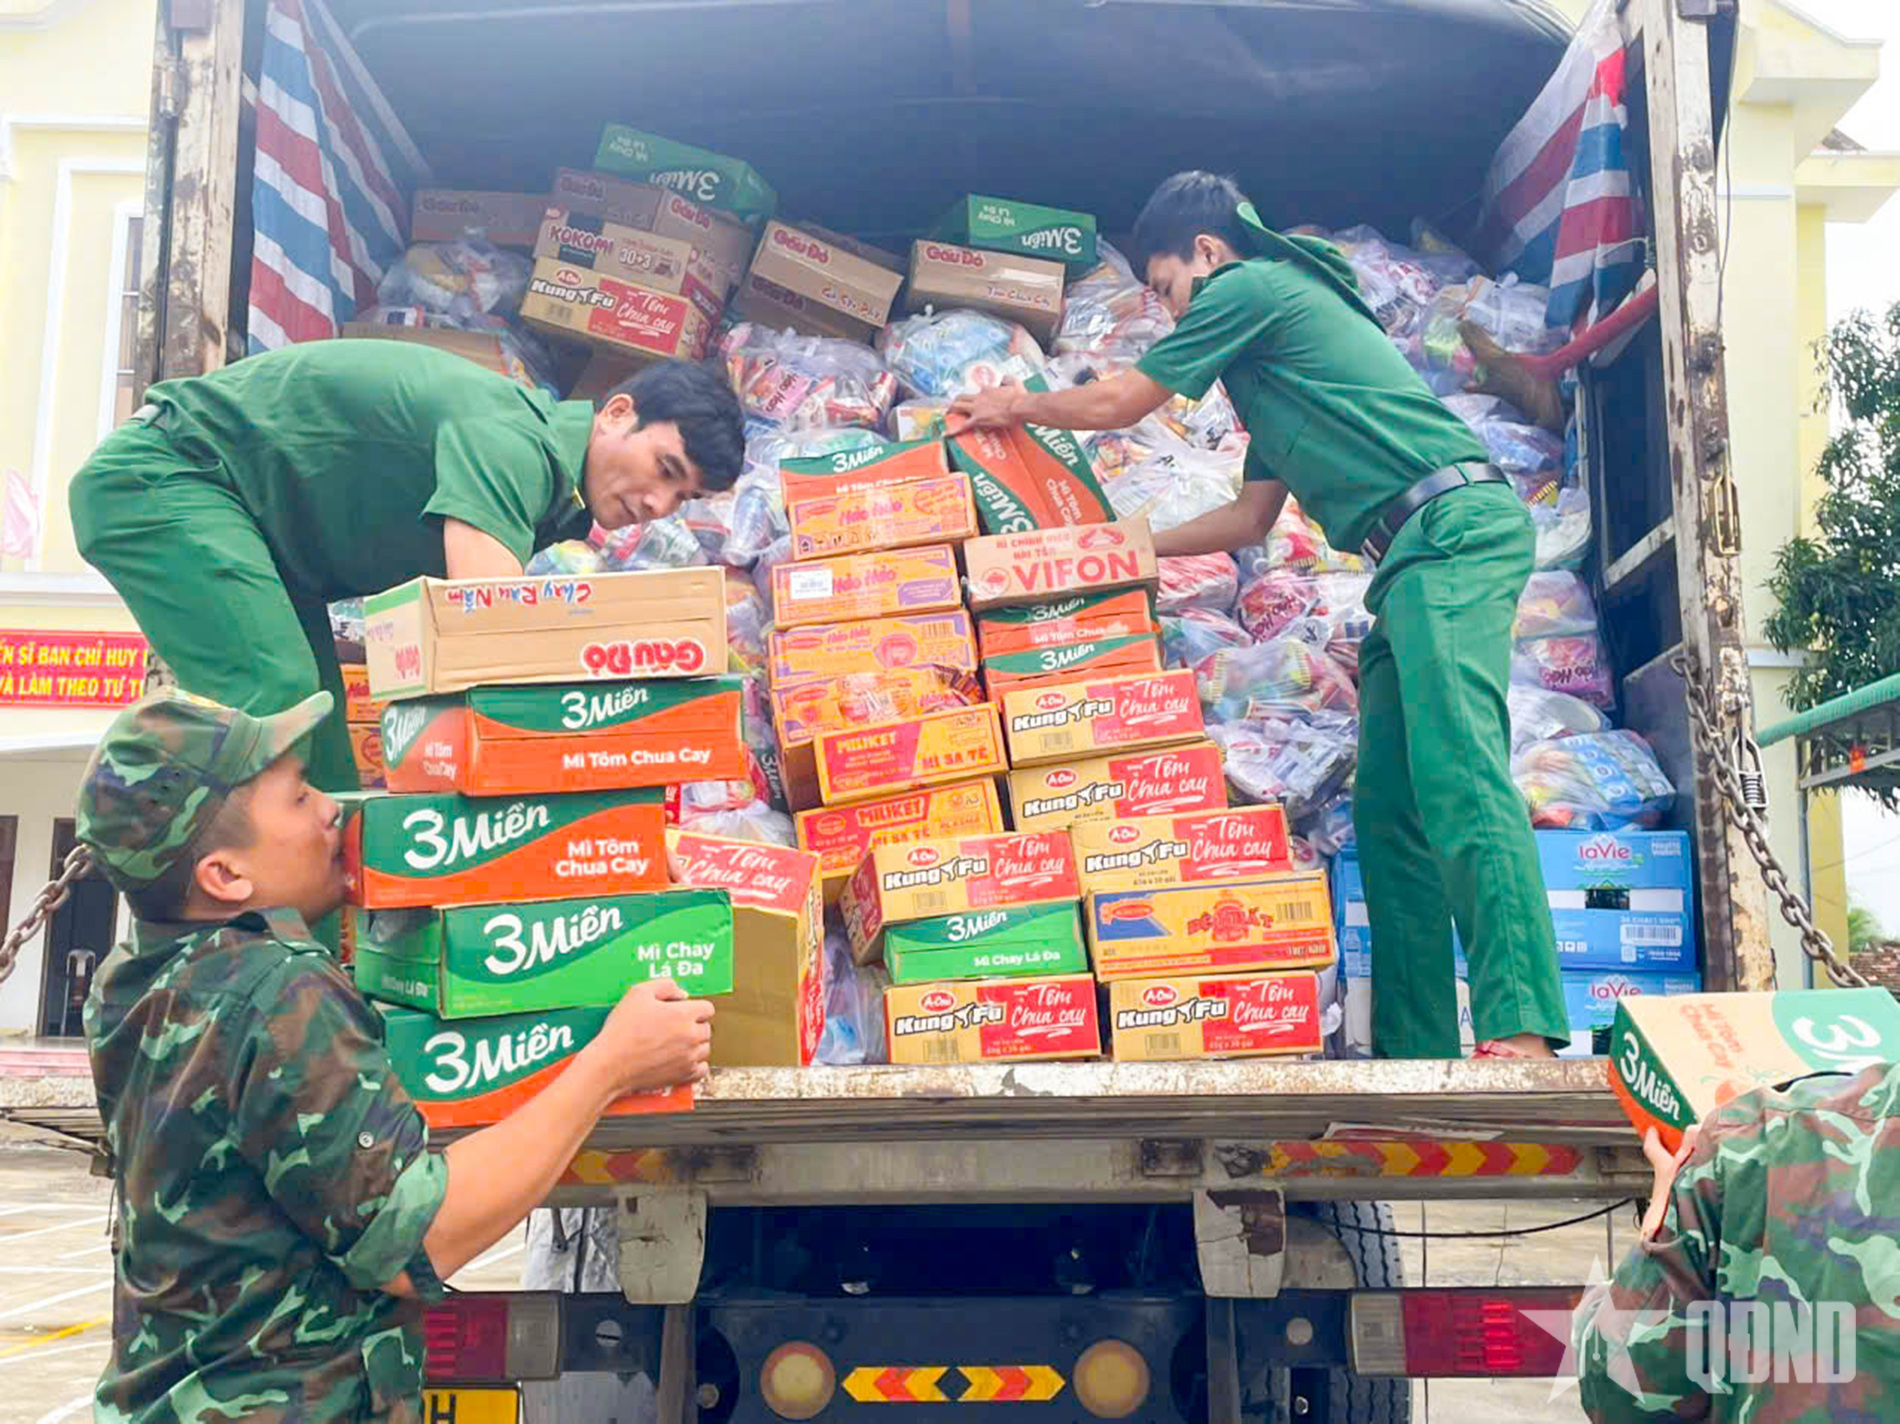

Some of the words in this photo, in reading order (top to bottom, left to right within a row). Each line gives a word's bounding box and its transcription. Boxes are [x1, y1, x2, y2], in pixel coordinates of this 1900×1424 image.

[550, 225, 614, 255] KOKOMI
[619, 249, 652, 271] 30+3
[530, 278, 577, 300] Kung
[593, 292, 617, 309] Fu
[1012, 550, 1140, 591] VIFON
[447, 585, 492, 613] Nấm
[499, 584, 537, 606] Rau
[543, 581, 592, 604] Chay
[38, 645, 70, 665] BAN
[107, 646, 138, 667] HUY
[58, 677, 99, 697] THEO
[1134, 678, 1176, 698] Tôm
[561, 691, 587, 729] 3
[586, 685, 649, 727] Miền
[1013, 709, 1068, 733] Kung
[1084, 699, 1114, 717] Fu
[1119, 697, 1158, 718] Chua
[1164, 696, 1190, 714] cay
[563, 752, 586, 769] Mì
[587, 749, 627, 767] Tôm
[630, 748, 676, 766] Chua
[678, 746, 711, 766] Cay
[1143, 754, 1189, 776] Tôm
[1023, 797, 1079, 818] Kung
[1096, 783, 1125, 801] Fu
[1128, 779, 1172, 801] Chua
[1179, 776, 1207, 794] cay
[857, 797, 925, 826] MILIKET
[402, 809, 449, 870] 3
[447, 799, 551, 865] Miền
[1208, 815, 1255, 840] Tôm
[568, 839, 592, 857] Mì
[595, 837, 639, 857] Tôm
[722, 844, 778, 871] Tôm
[1008, 834, 1050, 857] Tôm
[1085, 850, 1142, 873] Kung
[1159, 840, 1189, 859] Fu
[1192, 839, 1239, 861] Chua
[1243, 838, 1272, 859] cay
[556, 857, 609, 878] Chua
[612, 857, 650, 878] Cay
[686, 860, 749, 886] Chua
[752, 872, 792, 894] cay
[884, 867, 941, 891] Kung
[958, 857, 987, 876] Fu
[994, 857, 1036, 877] Chua
[1040, 856, 1065, 874] cay
[946, 916, 965, 941] 3
[964, 910, 1008, 940] Miền
[482, 913, 528, 975] 3
[523, 904, 623, 971] Miền
[638, 943, 662, 962] Mì
[666, 941, 716, 963] Chay
[676, 960, 704, 977] Đa
[974, 955, 990, 966] Mì
[992, 953, 1023, 967] Chay
[1027, 983, 1072, 1005] Tôm
[1250, 978, 1294, 1002] Tôm
[895, 1013, 954, 1037] Kung
[972, 1003, 1005, 1023] Fu
[1011, 1008, 1054, 1027] Chua
[1059, 1007, 1087, 1025] cay
[1117, 1007, 1178, 1029] Kung
[1194, 998, 1227, 1018] Fu
[1233, 1001, 1277, 1024] Chua
[1281, 1004, 1310, 1023] cay
[1791, 1014, 1882, 1050] 3
[424, 1031, 469, 1093] 3
[466, 1021, 574, 1089] Miền
[1620, 1031, 1640, 1085] 3
[1632, 1061, 1682, 1121] Miền
